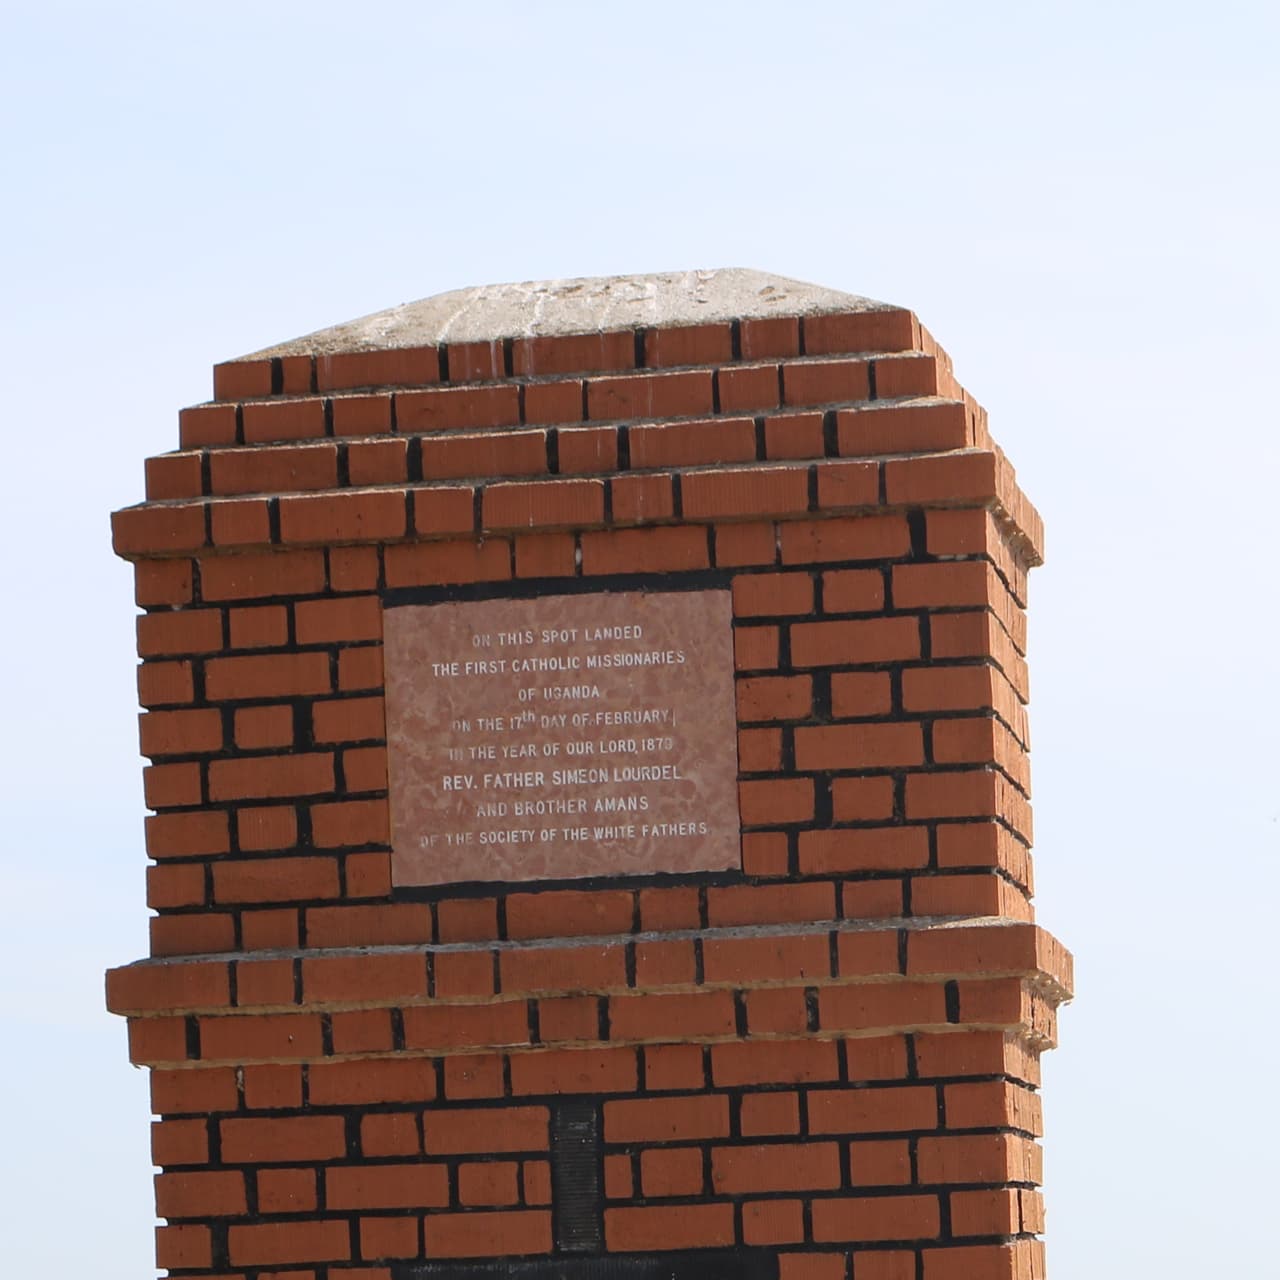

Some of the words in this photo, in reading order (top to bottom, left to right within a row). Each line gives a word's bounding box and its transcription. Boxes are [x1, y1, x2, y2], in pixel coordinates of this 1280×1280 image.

[473, 634, 491, 648] ON
[498, 631, 534, 646] THIS
[542, 629, 578, 644] SPOT
[585, 625, 642, 641] LANDED
[432, 663, 458, 677] THE
[465, 660, 506, 674] FIRST
[512, 656, 580, 672] CATHOLIC
[587, 650, 685, 668] MISSIONARIES
[519, 688, 536, 701] OF
[544, 685, 600, 698] UGANDA
[452, 719, 470, 732] ON
[478, 718, 504, 731] THE
[541, 715, 566, 729] DAY
[572, 713, 588, 726] OF
[470, 746, 496, 760] THE
[503, 743, 537, 758] YEAR
[543, 743, 560, 757] OF
[566, 741, 594, 755] OUR
[443, 774, 478, 791] REV.
[484, 772, 545, 788] FATHER
[552, 768, 608, 785] SIMEON
[614, 765, 681, 782] LOURDEL
[477, 802, 507, 817] AND
[515, 799, 587, 816] BROTHER
[595, 796, 649, 812] AMANS
[421, 834, 439, 848] OF
[446, 832, 472, 846] THE
[479, 830, 535, 845] SOCIETY
[541, 828, 557, 842] OF
[563, 828, 588, 841] THE
[593, 826, 635, 840] WHITE
